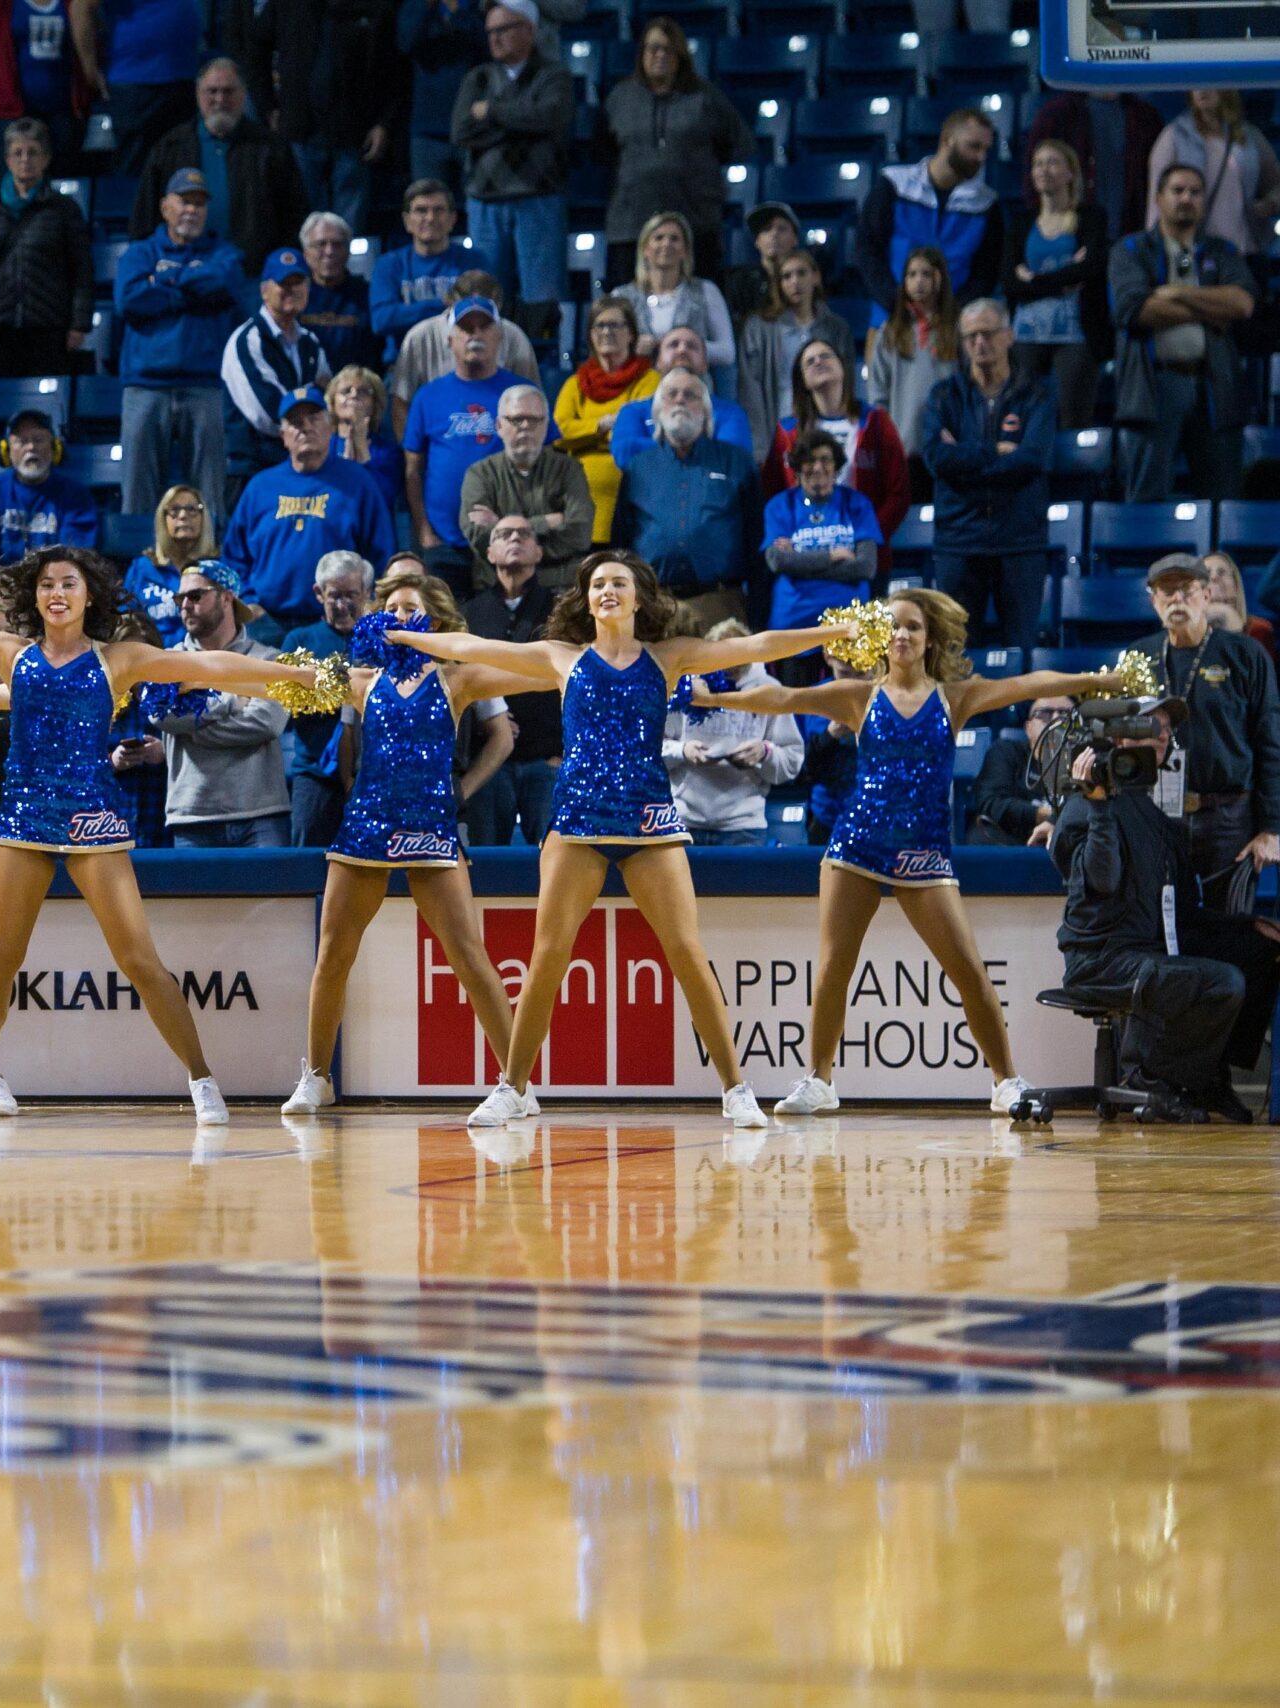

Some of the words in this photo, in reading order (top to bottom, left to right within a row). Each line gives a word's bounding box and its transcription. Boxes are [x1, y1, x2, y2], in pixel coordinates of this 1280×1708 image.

[1087, 46, 1151, 62] SPALDING
[69, 811, 130, 842] Tulsa
[641, 802, 686, 834] Tul
[387, 830, 452, 858] Tulsa
[894, 849, 954, 877] Tulsa
